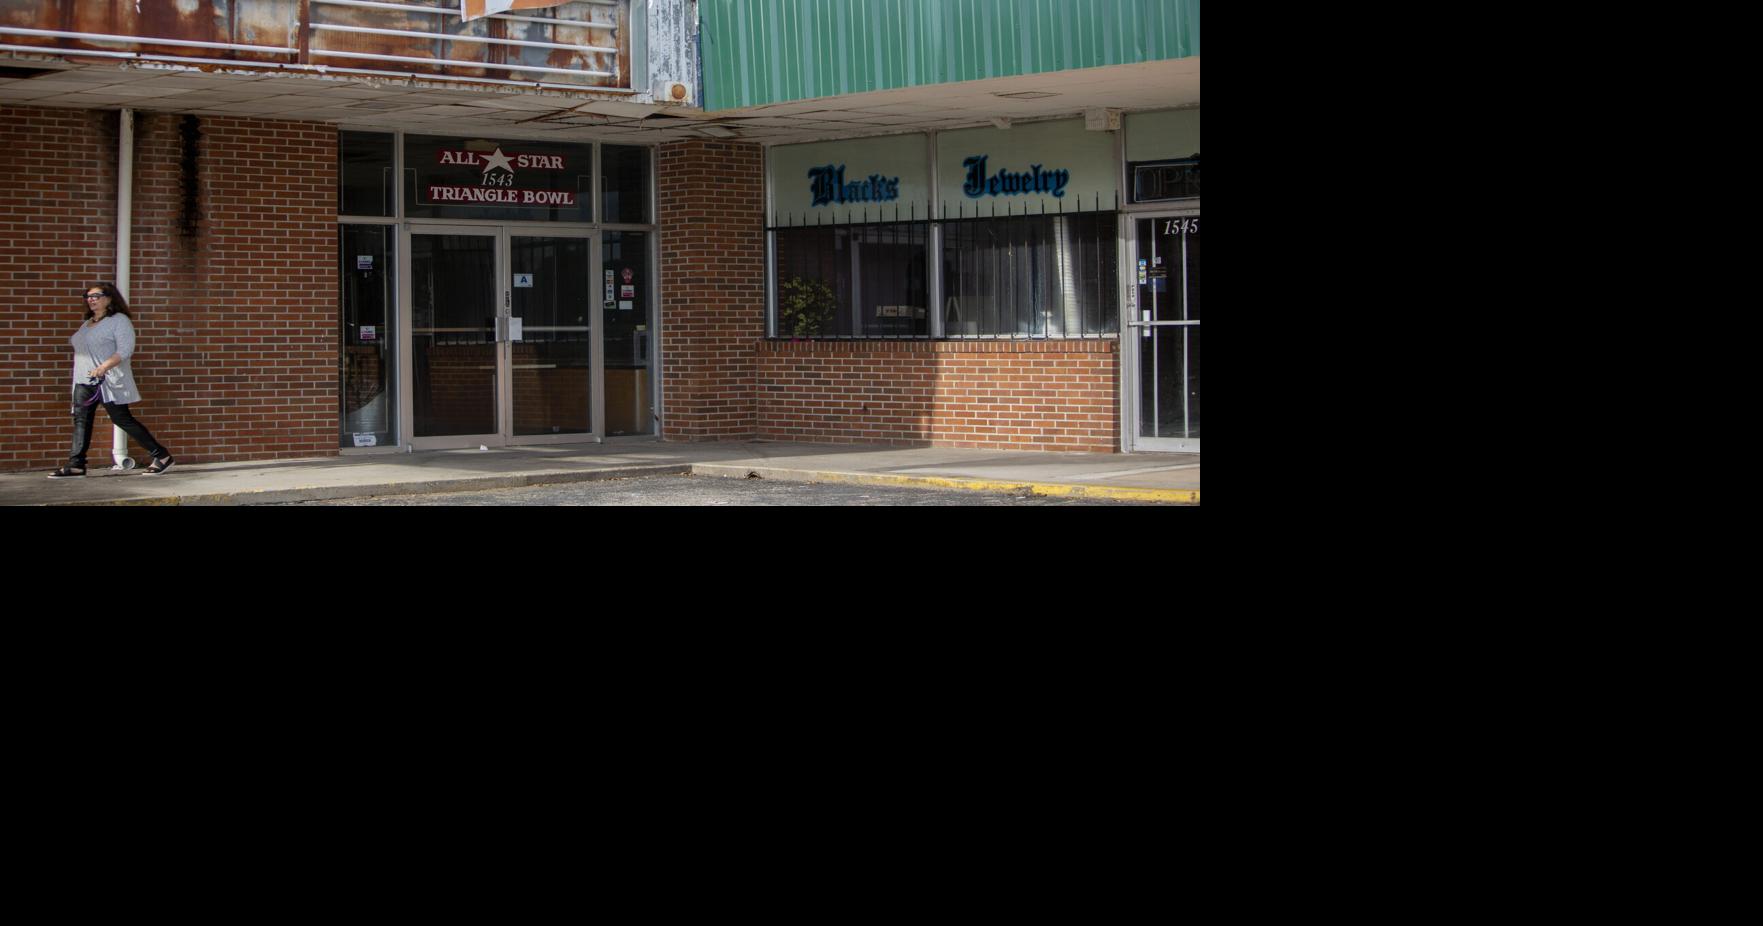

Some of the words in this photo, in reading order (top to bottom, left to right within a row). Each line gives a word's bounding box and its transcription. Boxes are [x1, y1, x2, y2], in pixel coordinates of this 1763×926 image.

[440, 151, 480, 165] ALL
[517, 154, 564, 169] STAR
[481, 173, 513, 187] 1543
[962, 154, 1070, 199] Jewelry
[430, 186, 518, 203] TRIANGLE
[522, 190, 574, 205] BOWL
[1164, 218, 1199, 235] 1545
